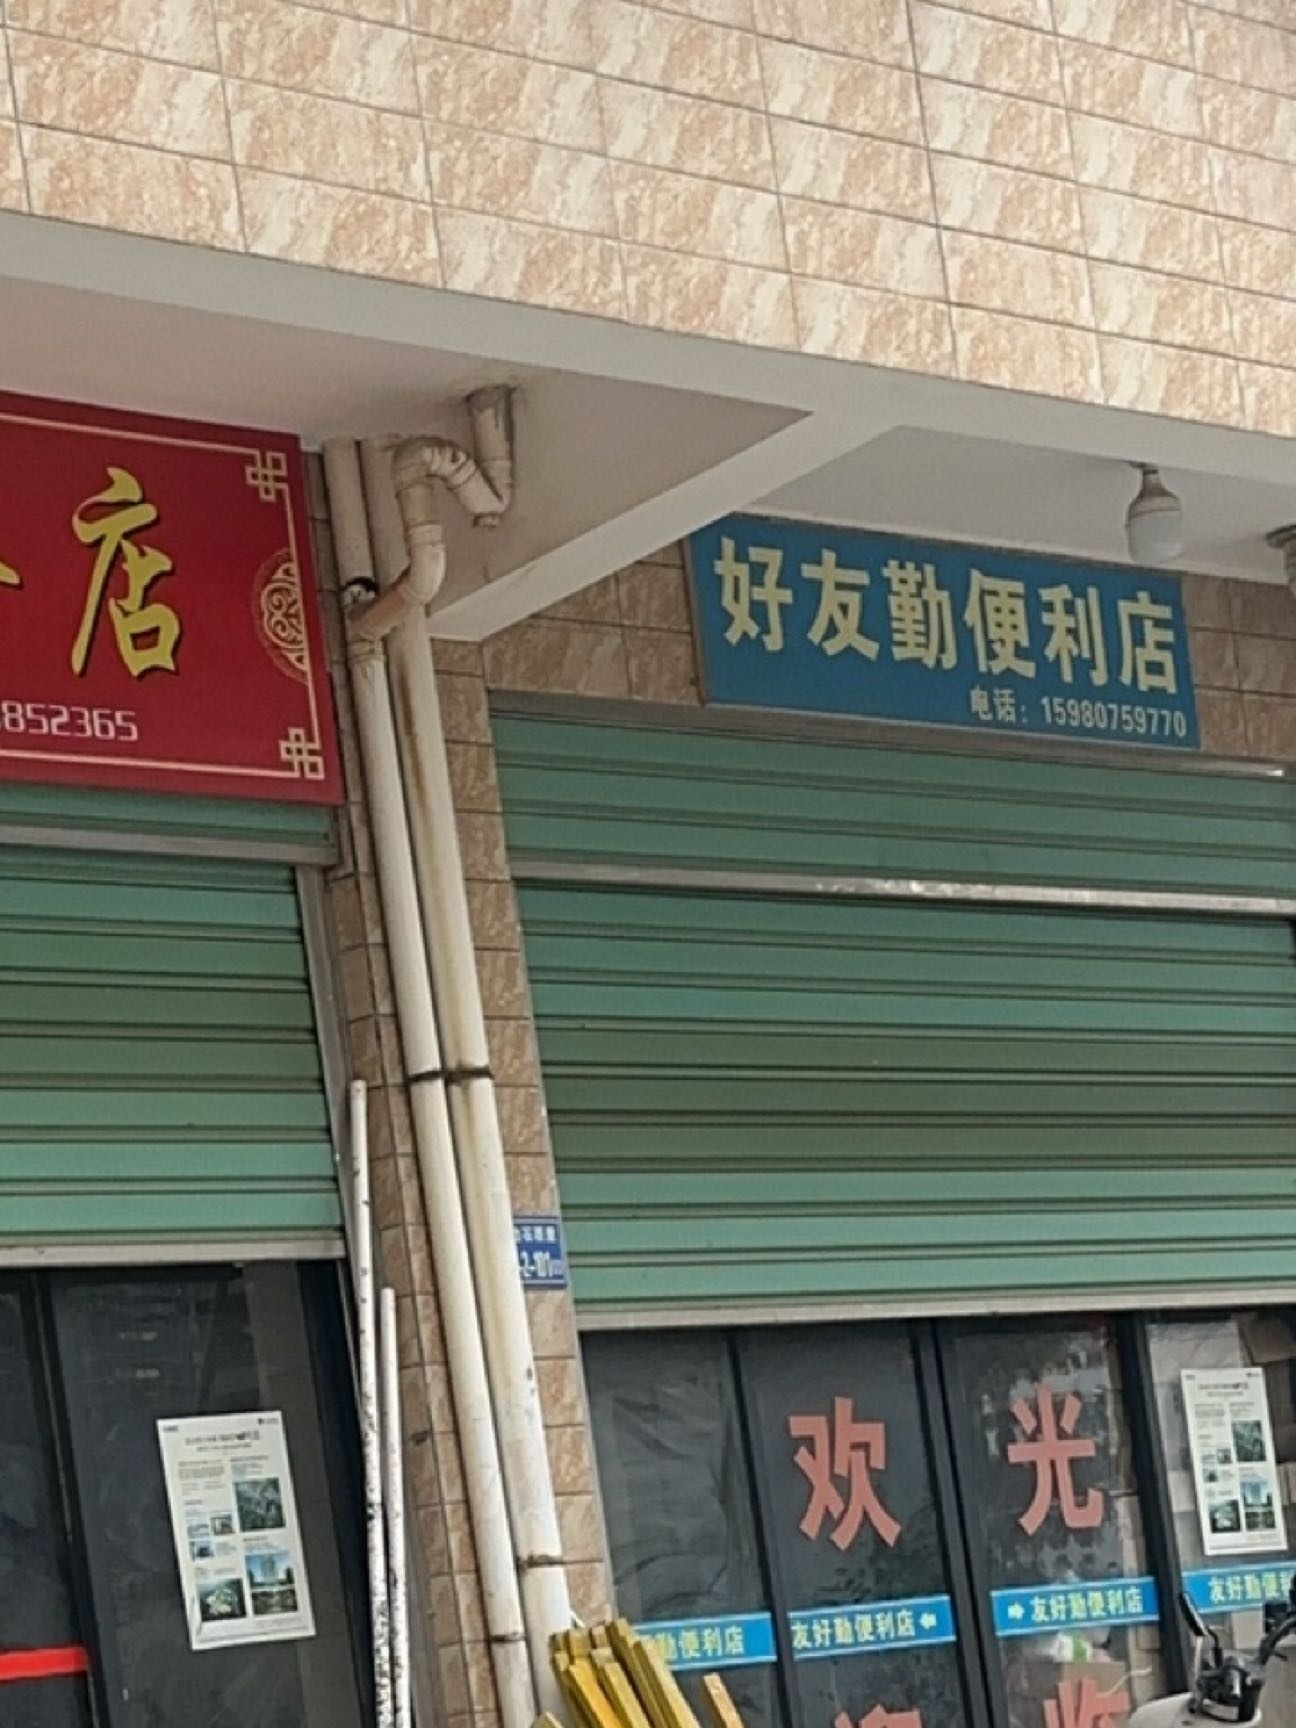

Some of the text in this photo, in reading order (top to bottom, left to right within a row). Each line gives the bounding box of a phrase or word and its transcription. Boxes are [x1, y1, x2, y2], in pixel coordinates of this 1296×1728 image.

[714, 537, 1177, 694] 好友勤便利店
